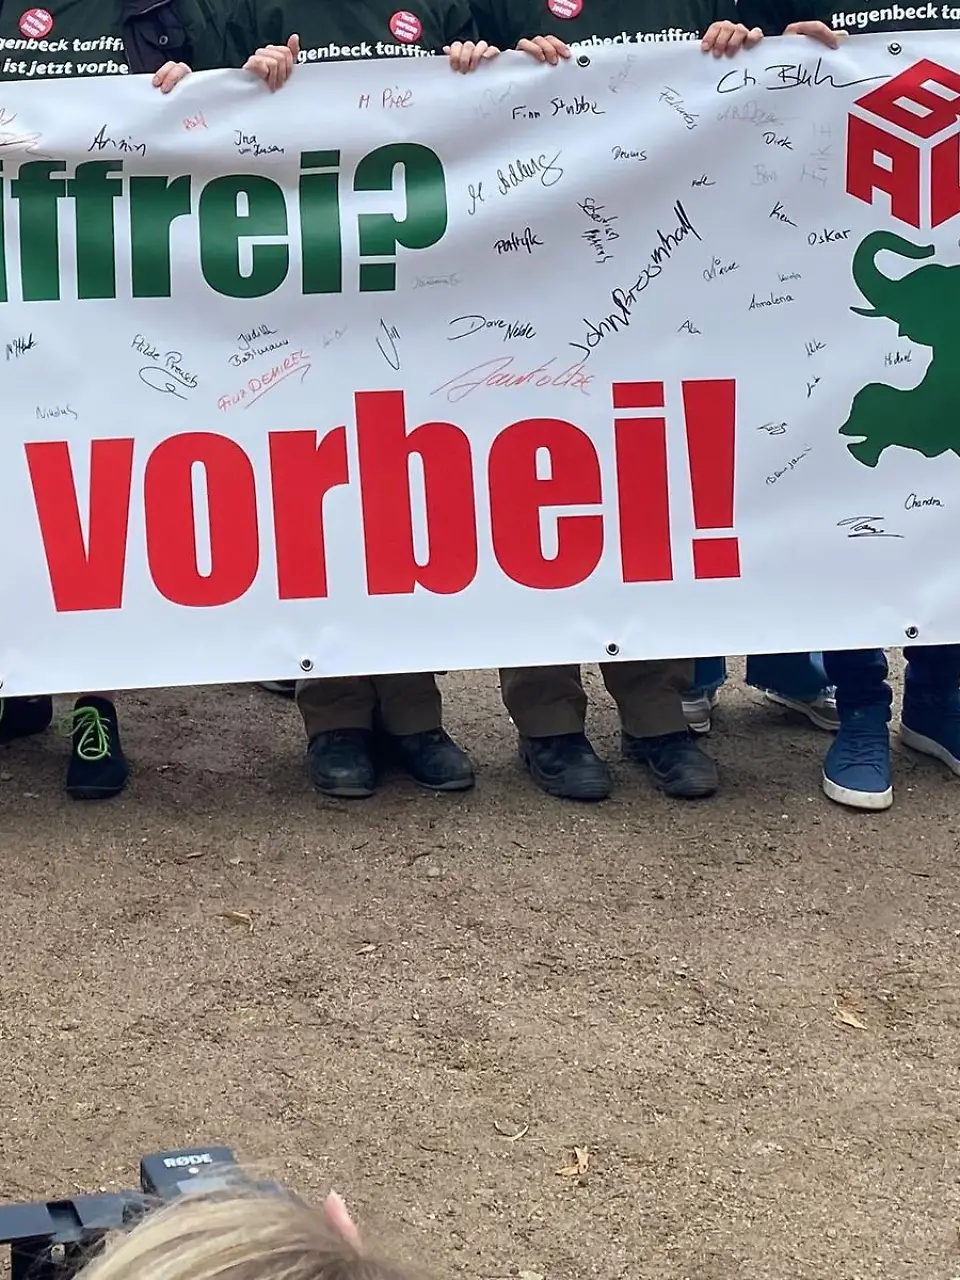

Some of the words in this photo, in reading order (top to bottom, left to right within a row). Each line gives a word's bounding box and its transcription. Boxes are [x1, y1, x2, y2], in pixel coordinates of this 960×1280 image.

[831, 2, 938, 29] Hagenbeck
[3, 58, 26, 74] ist
[25, 60, 72, 77] jetzt
[807, 228, 851, 246] Oskar
[447, 315, 507, 341] Dave
[24, 379, 741, 613] vorbei!
